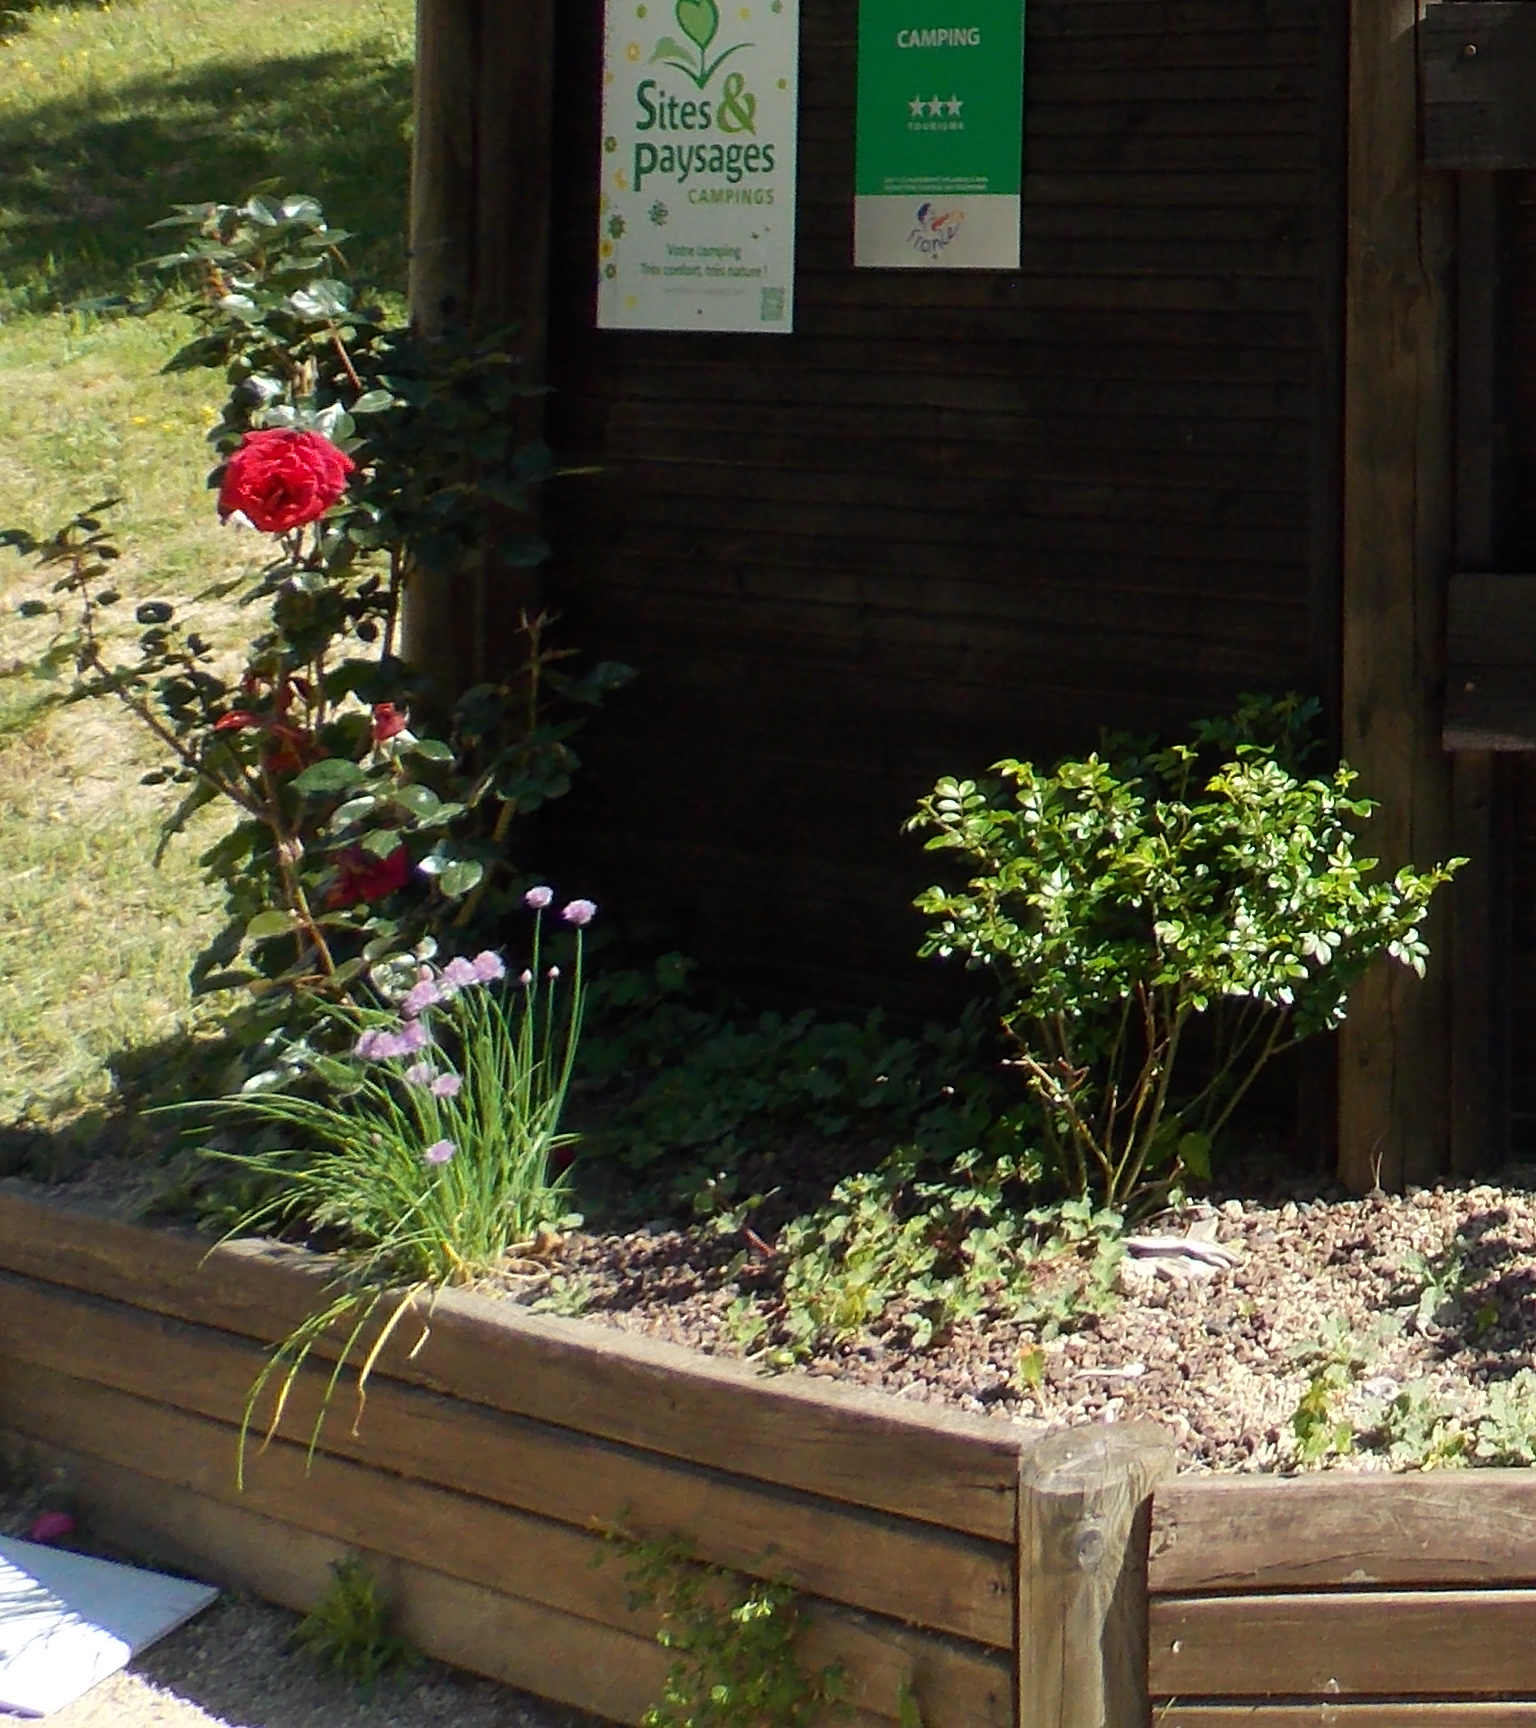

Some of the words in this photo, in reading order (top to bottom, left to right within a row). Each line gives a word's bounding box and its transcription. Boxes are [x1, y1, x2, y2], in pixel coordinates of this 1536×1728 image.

[897, 28, 980, 48] CAMPING
[636, 79, 712, 131] Sites
[717, 72, 757, 135] &
[688, 188, 774, 205] CAMPINGS
